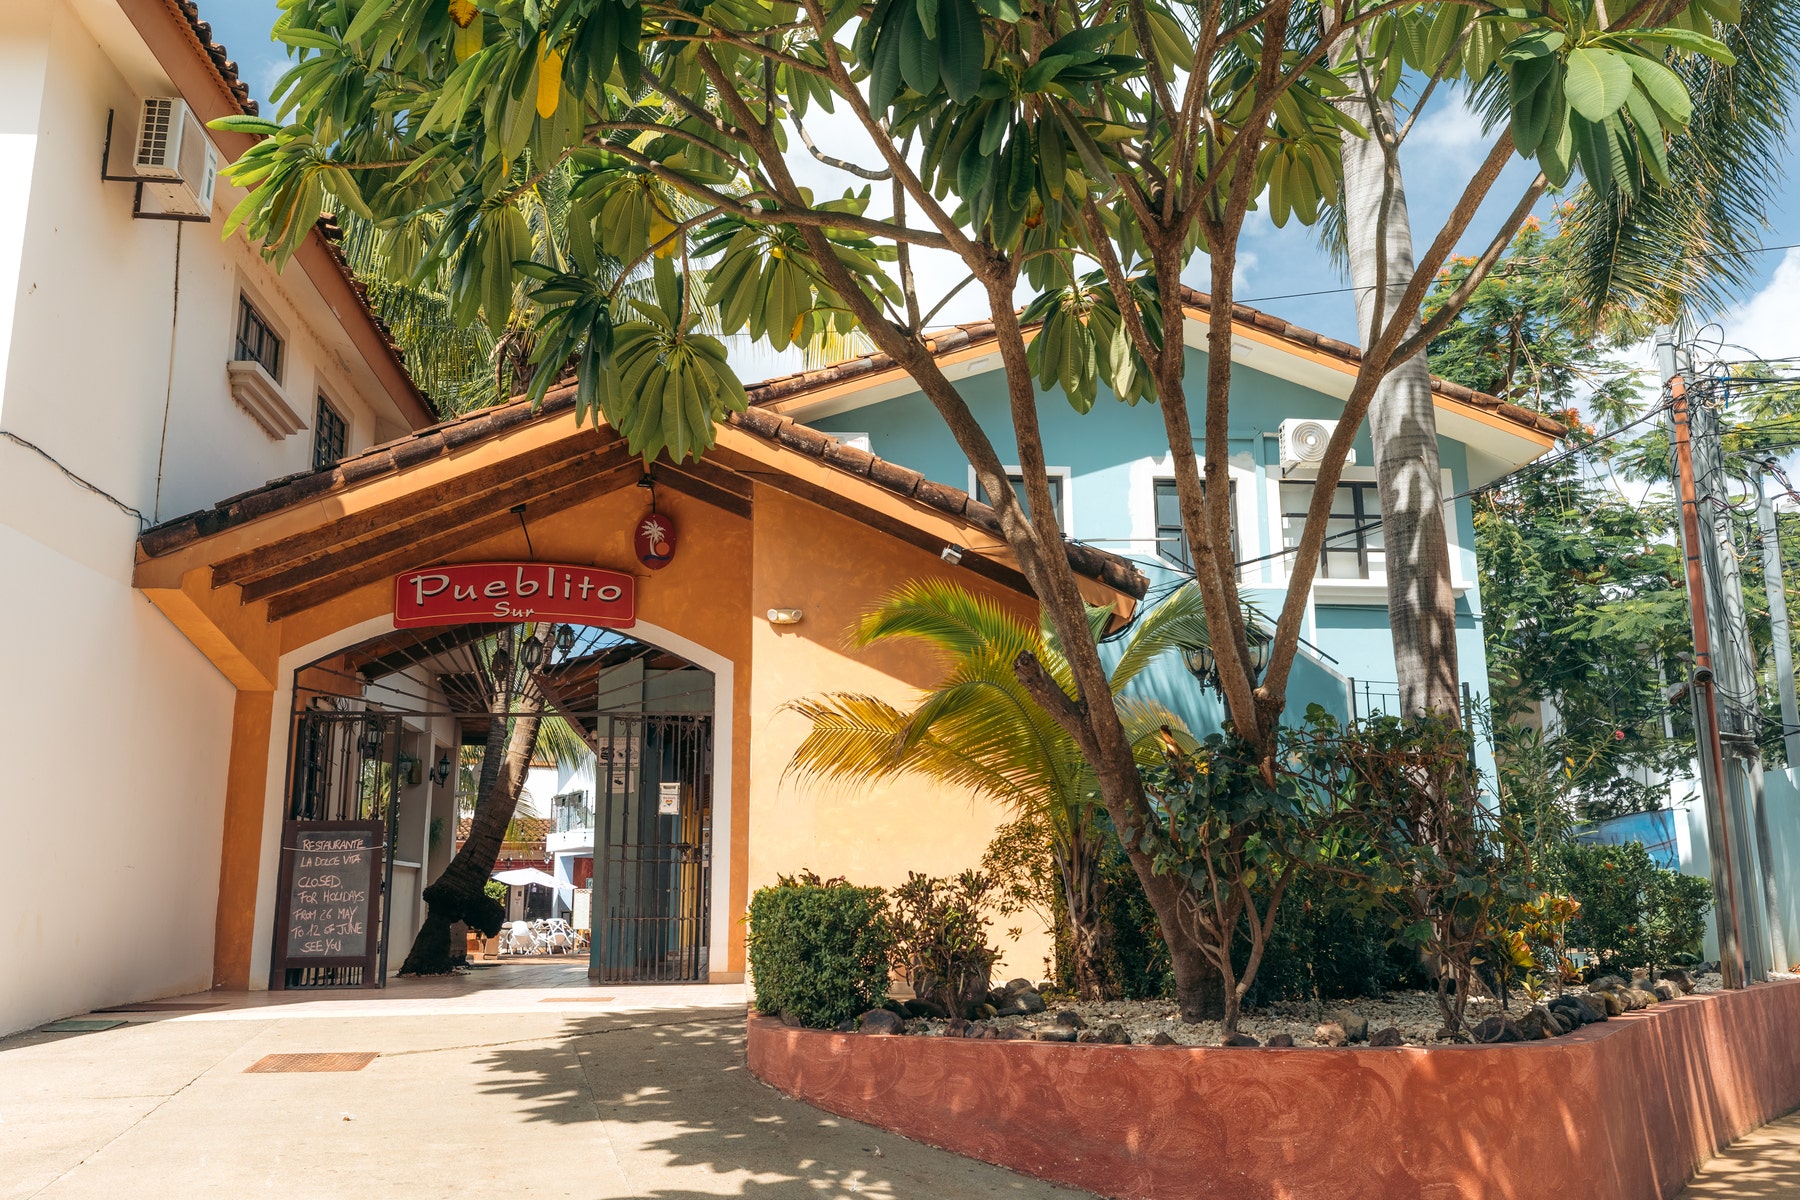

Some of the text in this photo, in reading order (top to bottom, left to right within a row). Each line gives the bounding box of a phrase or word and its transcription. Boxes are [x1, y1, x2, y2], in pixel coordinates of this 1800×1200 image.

[410, 566, 622, 605] Pueblito
[493, 601, 535, 618] Sur
[303, 839, 366, 850] RESTAURANTE
[300, 853, 362, 868] LA DOLCE VITA
[297, 890, 365, 904] FOR HOLIDAYS
[293, 906, 358, 923] FROM 26 MAY
[291, 922, 363, 939] TO 12 OF JUNE
[300, 940, 324, 953] SEE
